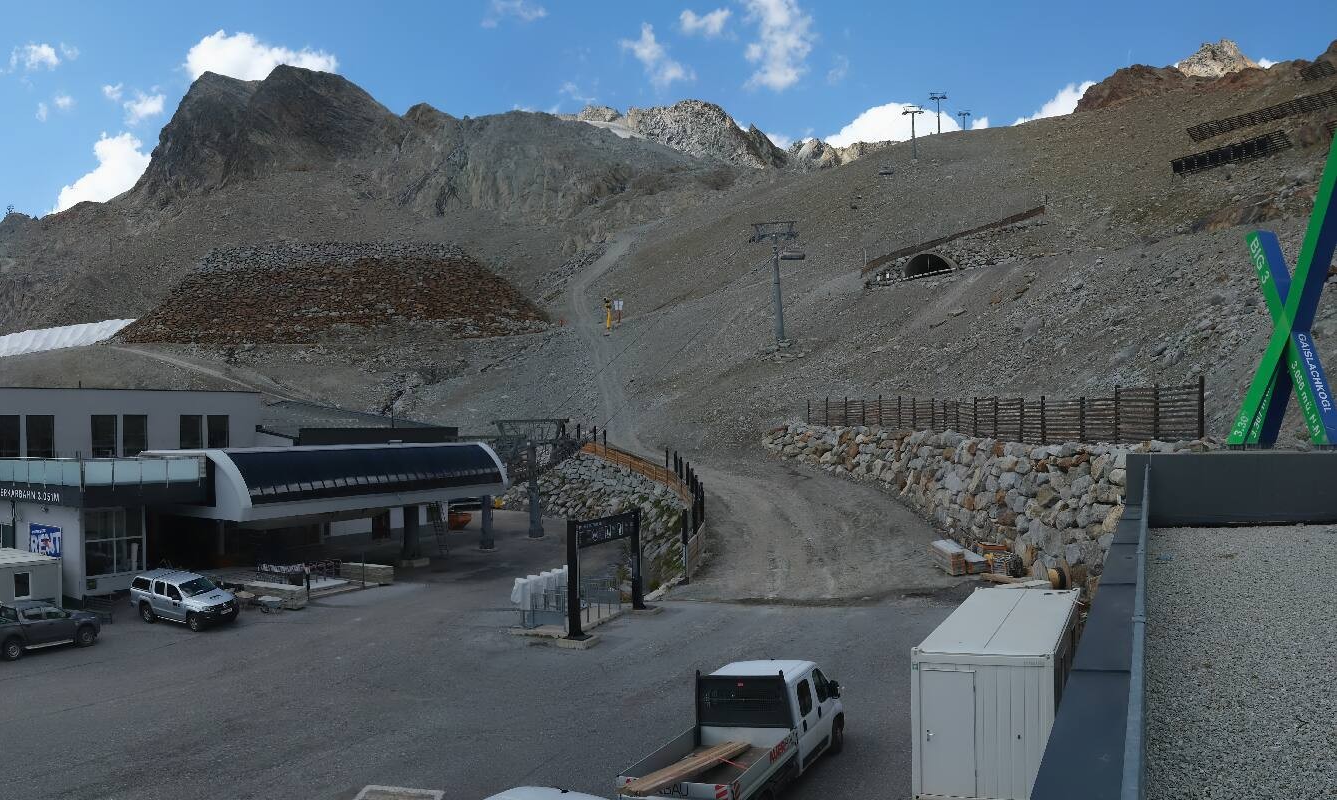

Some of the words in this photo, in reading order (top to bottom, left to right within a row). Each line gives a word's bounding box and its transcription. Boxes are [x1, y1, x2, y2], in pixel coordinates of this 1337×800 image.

[1250, 236, 1265, 270] BIG
[1261, 270, 1270, 284] 3
[1298, 333, 1332, 413] GAISLACHKOGL
